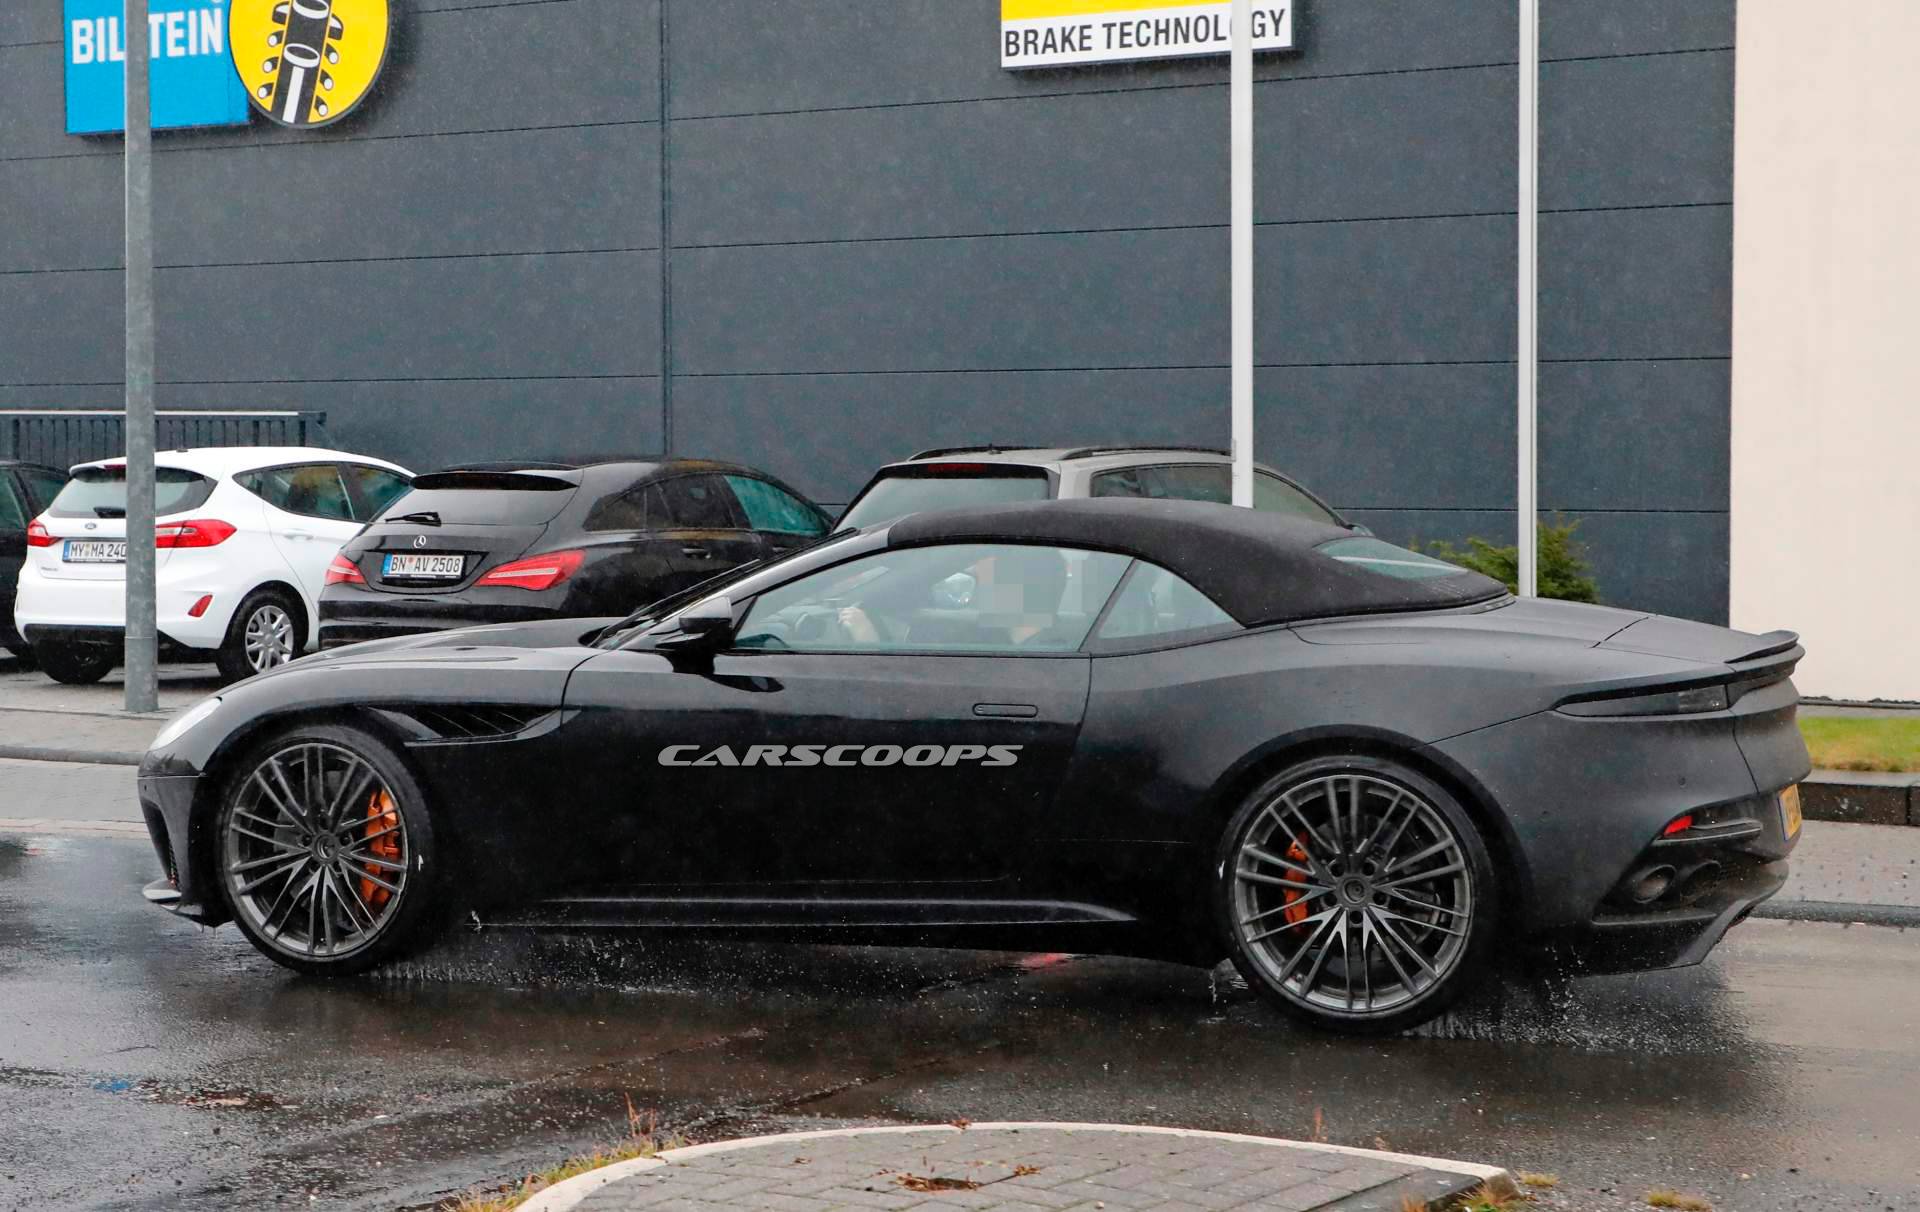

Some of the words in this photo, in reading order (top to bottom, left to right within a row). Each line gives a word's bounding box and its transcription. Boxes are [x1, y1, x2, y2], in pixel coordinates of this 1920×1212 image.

[71, 7, 223, 64] BILTEIN
[1005, 24, 1093, 57] BRAKE
[1102, 8, 1286, 49] TECHNOLGY
[391, 556, 407, 572] BN
[415, 557, 430, 572] AV
[431, 557, 461, 573] 2508
